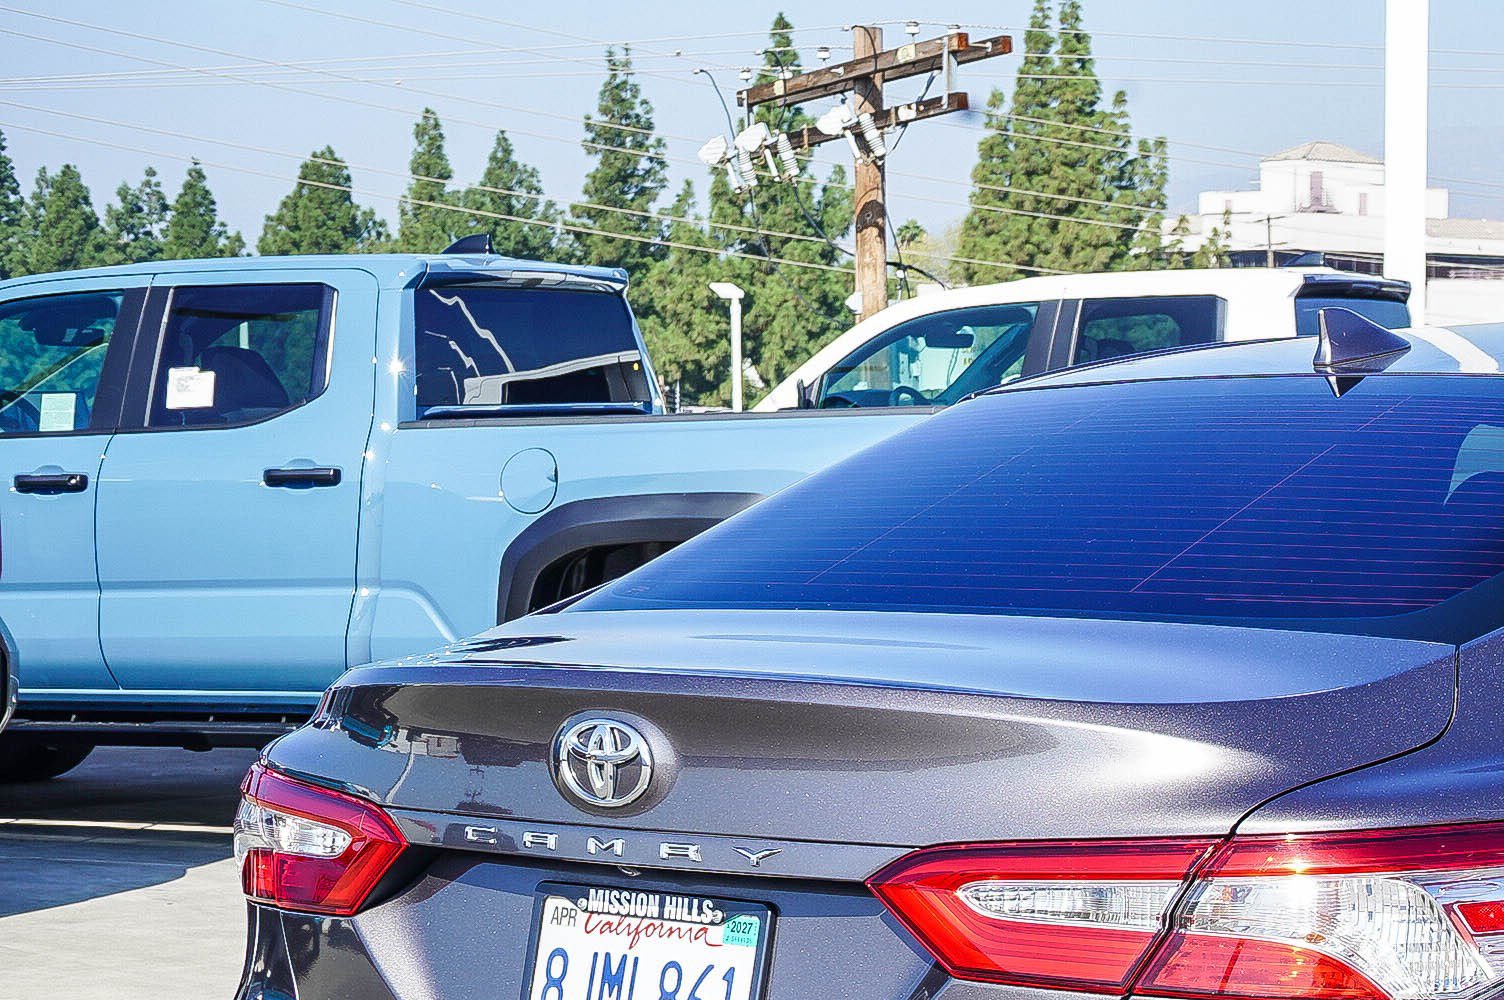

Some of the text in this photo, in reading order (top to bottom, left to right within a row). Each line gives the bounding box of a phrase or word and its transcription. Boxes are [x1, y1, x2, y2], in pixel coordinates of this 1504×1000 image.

[464, 826, 783, 867] CAMRY
[550, 905, 578, 927] APR
[588, 888, 714, 924] MISSION HILLS
[584, 911, 724, 950] California
[730, 920, 754, 935] 2027
